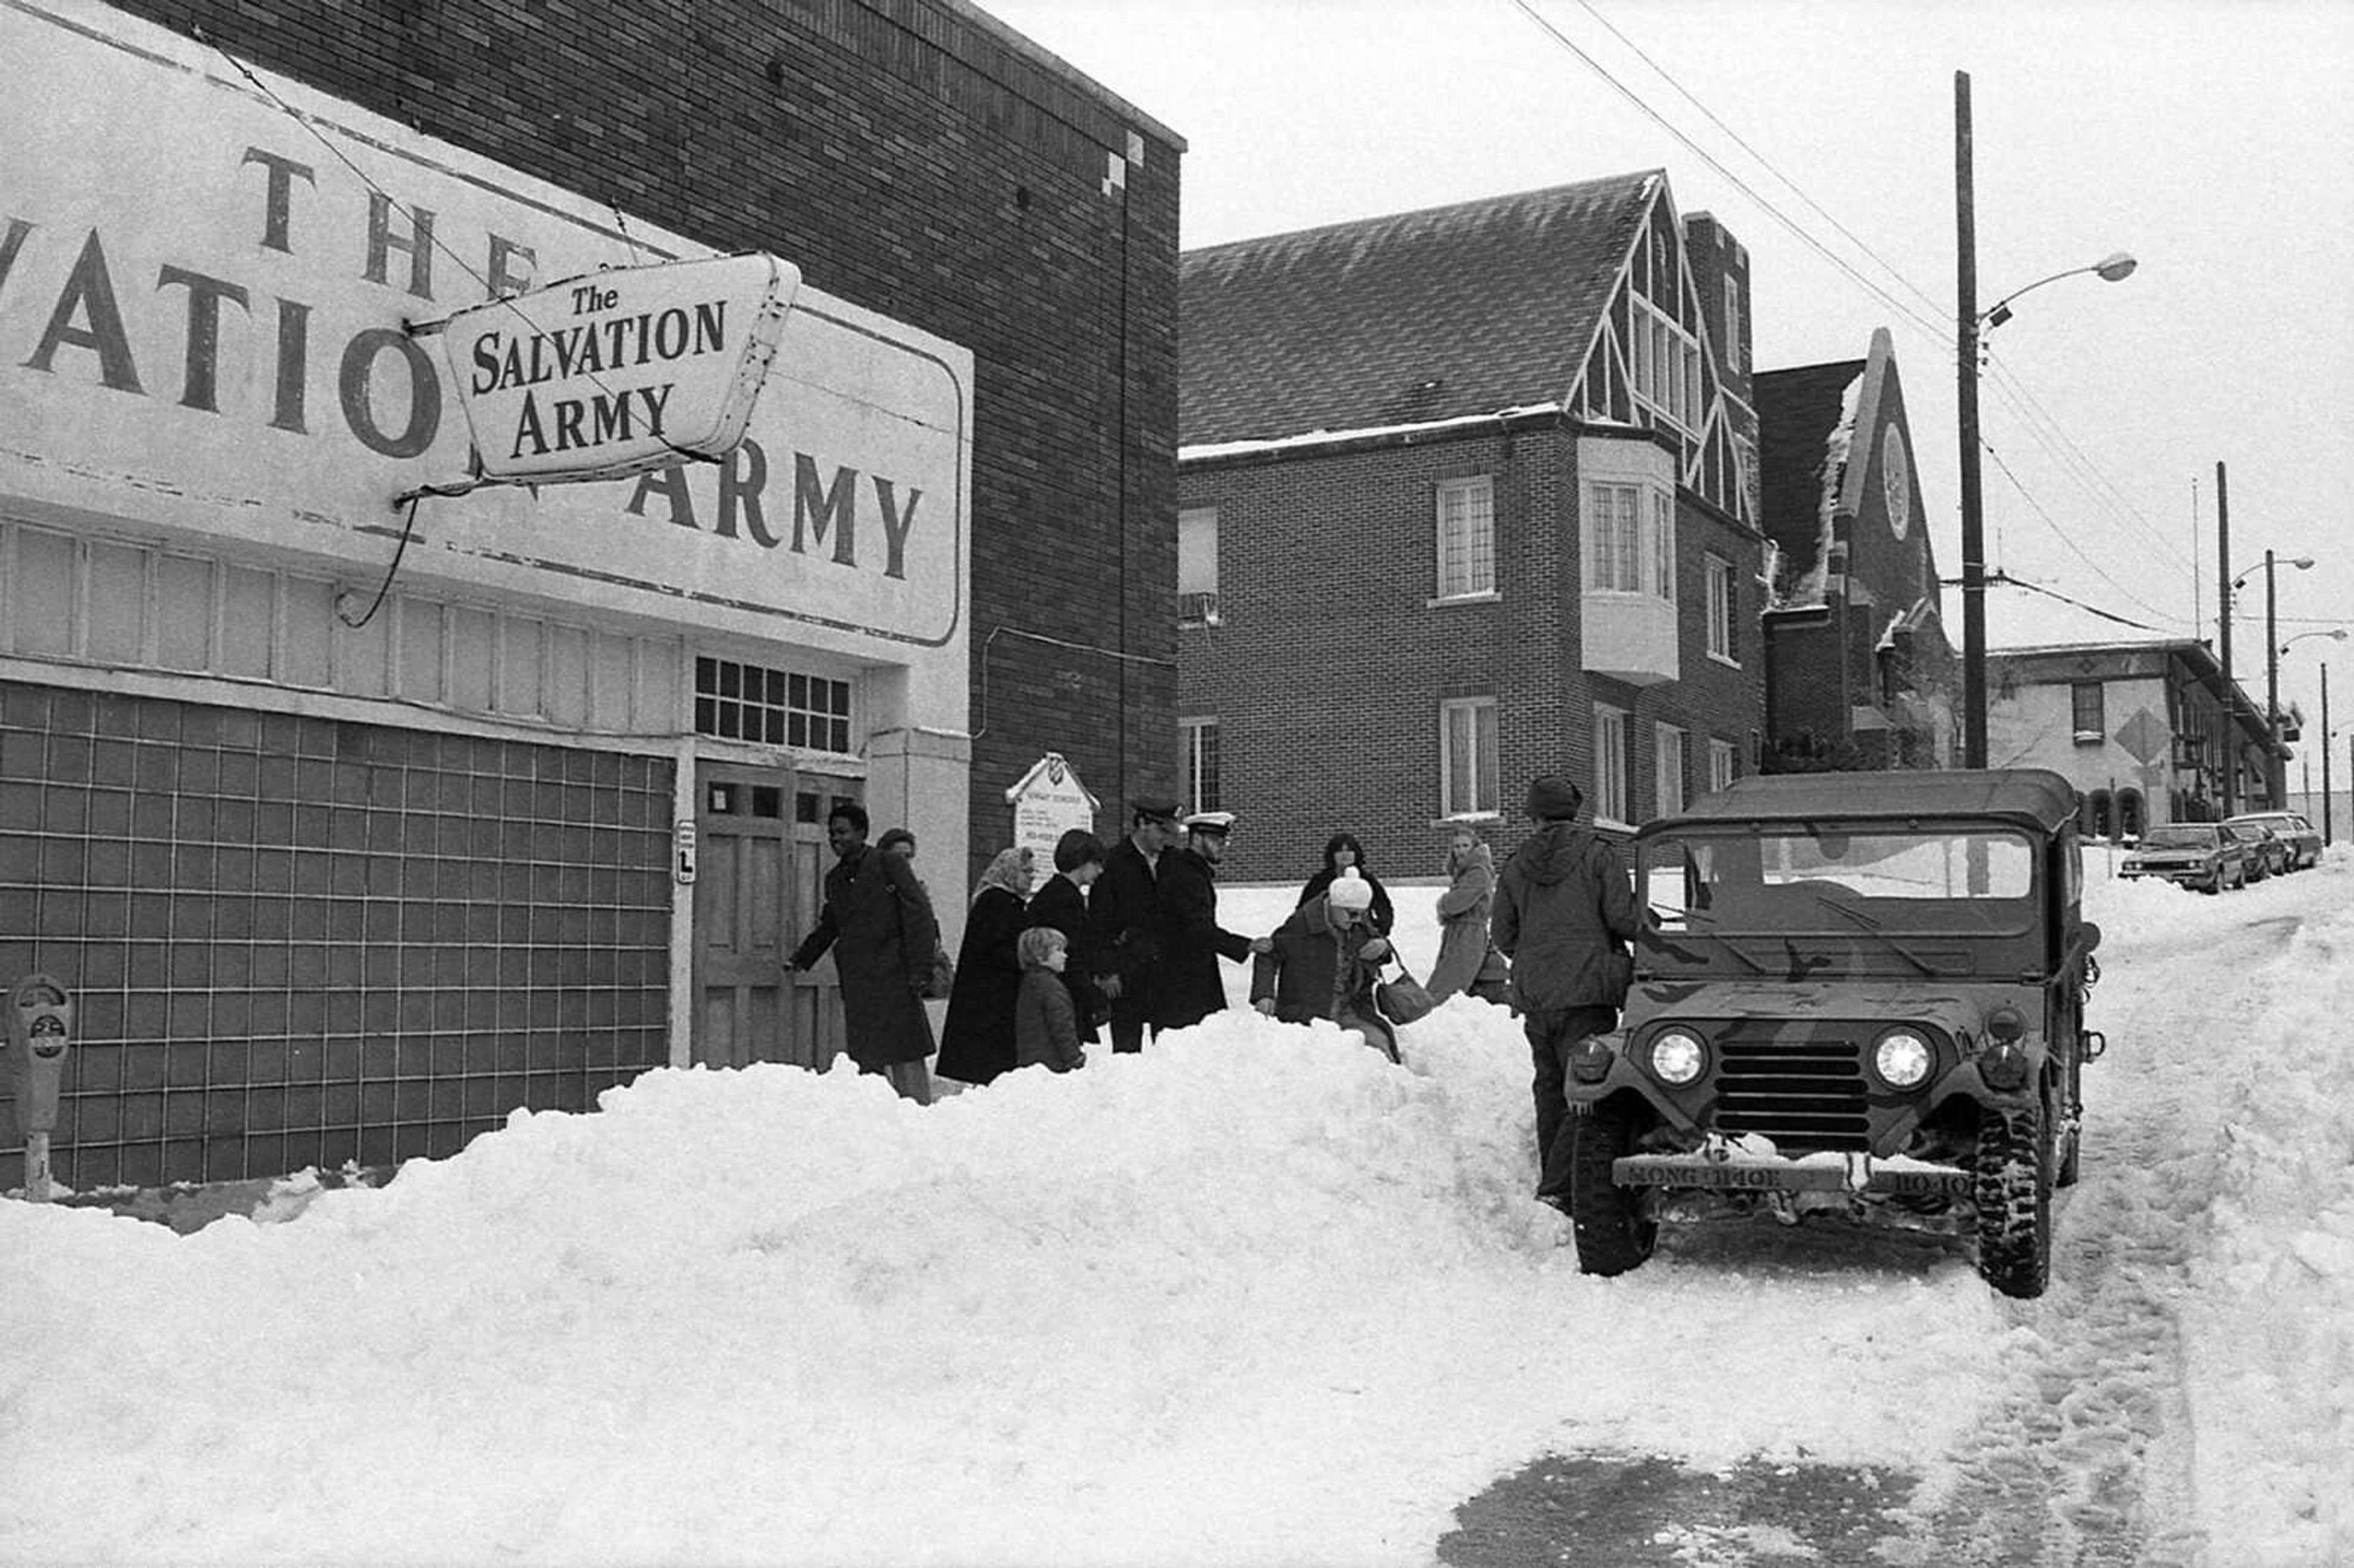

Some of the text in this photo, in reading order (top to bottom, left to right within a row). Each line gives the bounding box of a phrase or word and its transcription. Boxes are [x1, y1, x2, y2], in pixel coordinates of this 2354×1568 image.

[240, 146, 538, 303] THE
[472, 300, 728, 397] SALVATION
[572, 285, 618, 315] The
[0, 218, 538, 501] ATIO
[510, 384, 675, 459] ARMY
